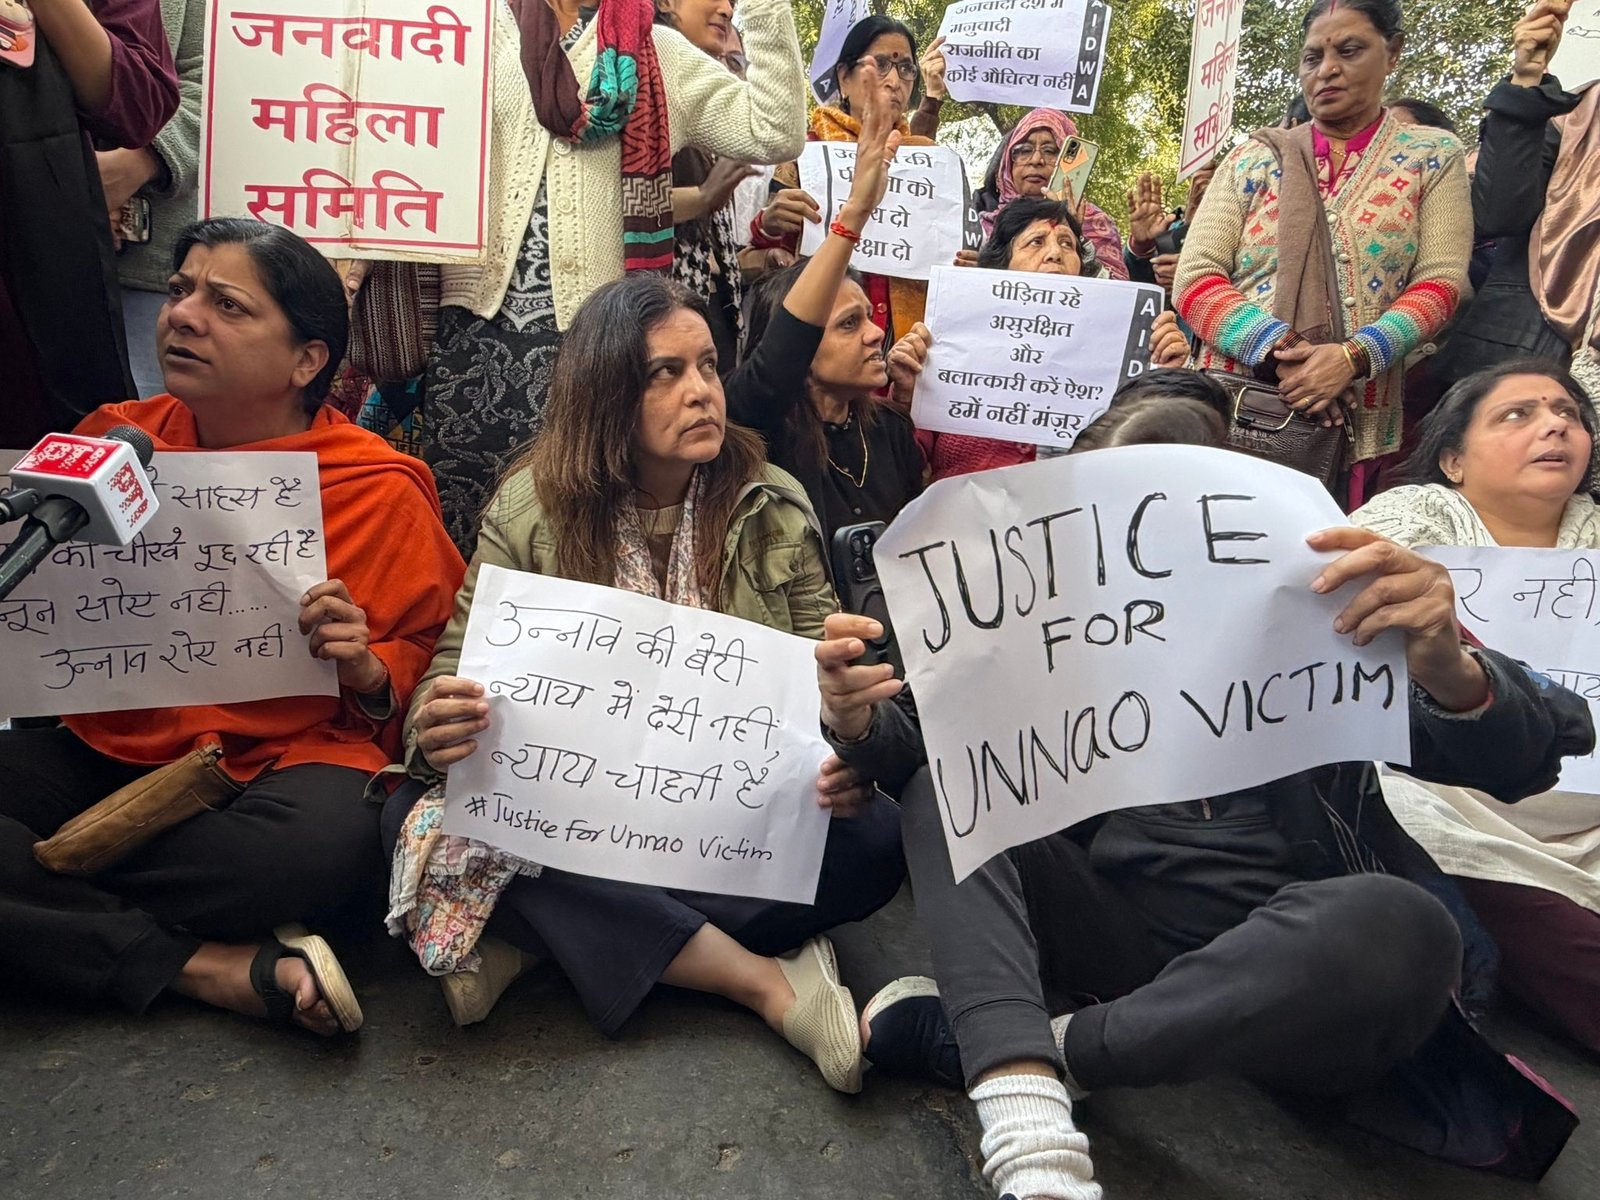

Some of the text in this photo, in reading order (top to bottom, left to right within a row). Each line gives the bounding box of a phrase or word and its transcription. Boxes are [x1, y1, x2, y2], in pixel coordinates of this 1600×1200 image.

[230, 5, 472, 66] जनवादी
[950, 17, 1012, 36] मनुवादी
[947, 41, 1042, 61] राजनीति का
[947, 65, 1076, 90] कोई औचित्य नहीं
[251, 83, 445, 149] महिला
[903, 152, 933, 168] की
[244, 168, 444, 234] समिति
[907, 177, 936, 200] को
[889, 205, 911, 228] दो
[892, 238, 913, 261] दो
[992, 280, 1083, 309] पीड़िता रहे
[990, 315, 1074, 338] असुरक्षित
[1010, 344, 1045, 364] और
[938, 369, 1104, 400] बलात्कारी करें ऐश?
[949, 395, 1084, 439] हमें नहीं मंज़ूर
[172, 485, 267, 512] साहस
[898, 492, 1271, 653] JUSTICE
[486, 601, 621, 655] उन्नाव
[636, 625, 677, 667] की
[1042, 599, 1166, 673] FOR
[490, 672, 595, 709] न्याय
[607, 680, 640, 720] में
[648, 695, 703, 742] देरी
[1180, 661, 1394, 738] VICTIM
[491, 743, 597, 788] न्याय
[606, 763, 723, 803] चाहती
[611, 824, 684, 853] Unnao
[700, 836, 774, 862] Victim
